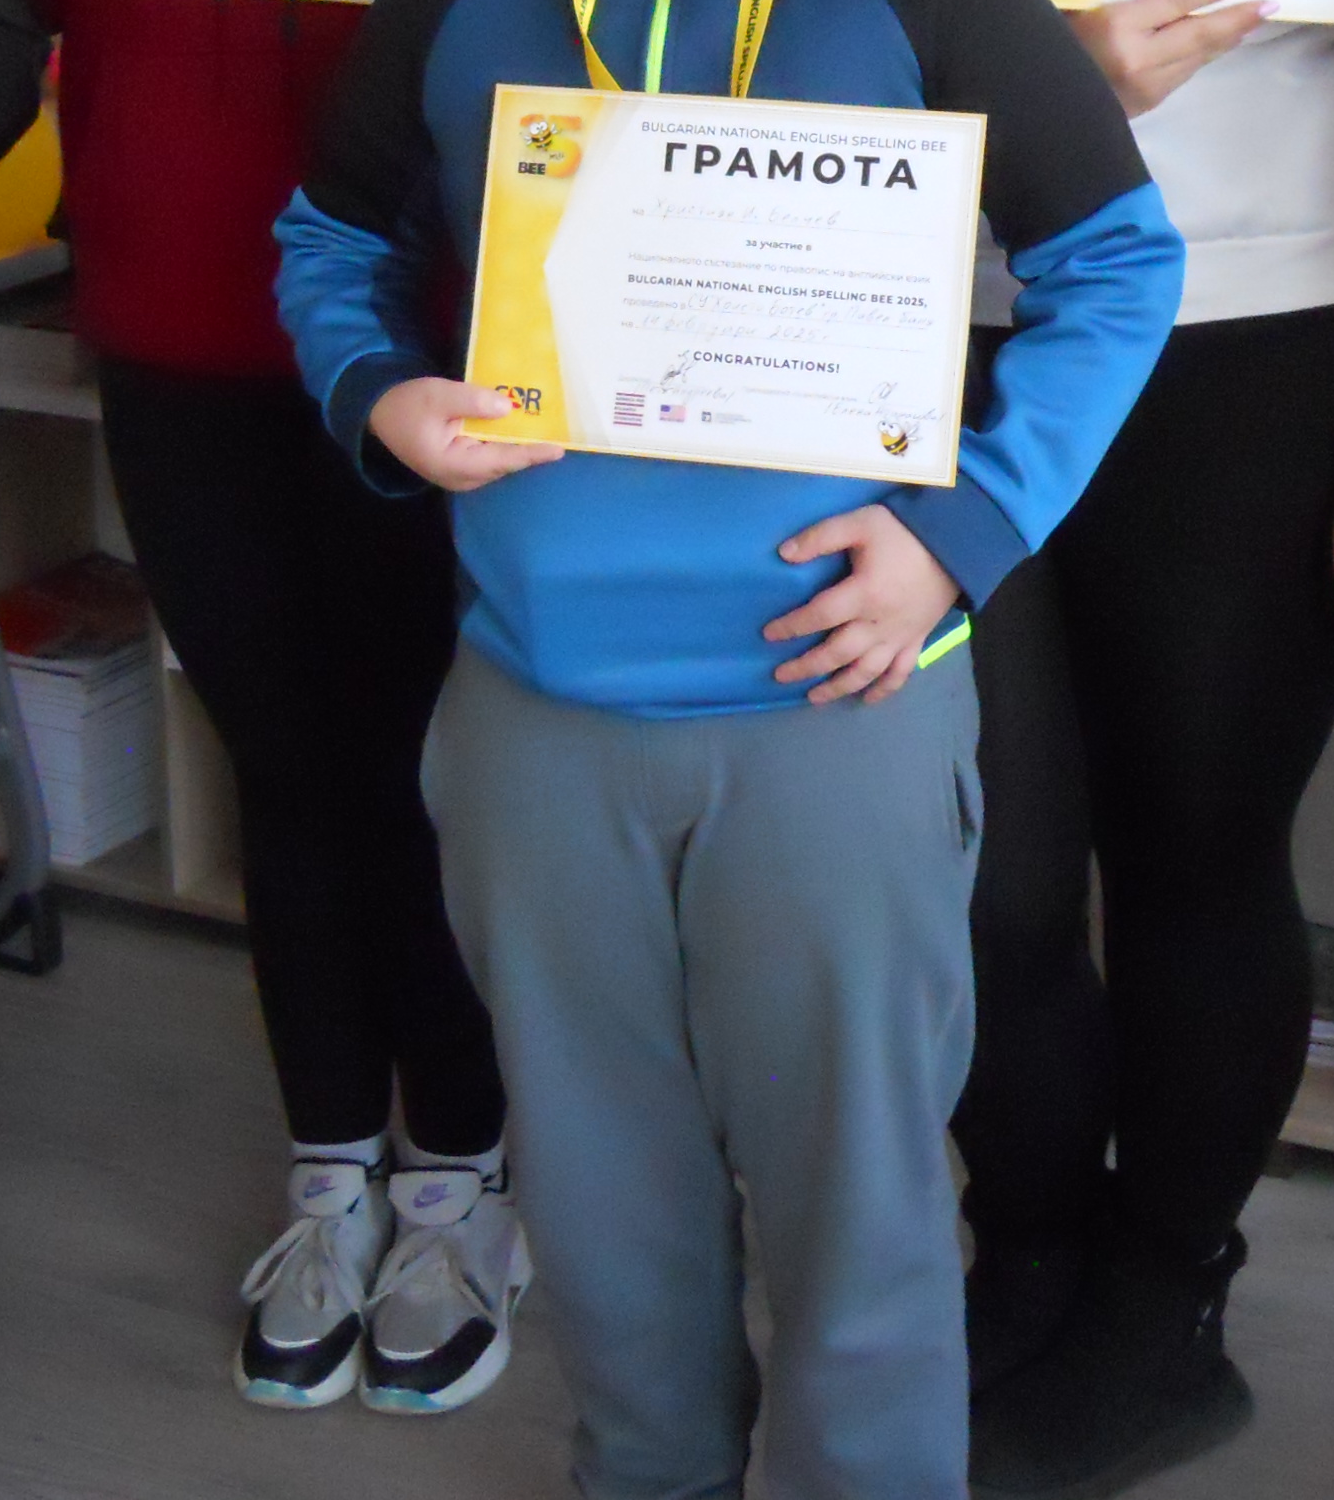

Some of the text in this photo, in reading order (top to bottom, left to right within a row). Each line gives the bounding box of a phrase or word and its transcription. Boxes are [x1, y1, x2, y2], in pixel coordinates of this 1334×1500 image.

[641, 121, 948, 153] BULGARIAN NATIONAL ENGLISH SPELLING BEE
[518, 160, 547, 176] BEE
[663, 142, 918, 190] ГРАМОТА
[745, 239, 758, 248] за
[759, 240, 803, 253] участие
[627, 274, 928, 310] BULGARIAN NATIONAL ENGLISH SPELLING BEE 2025,
[693, 350, 841, 374] CONGRATULATIONS!
